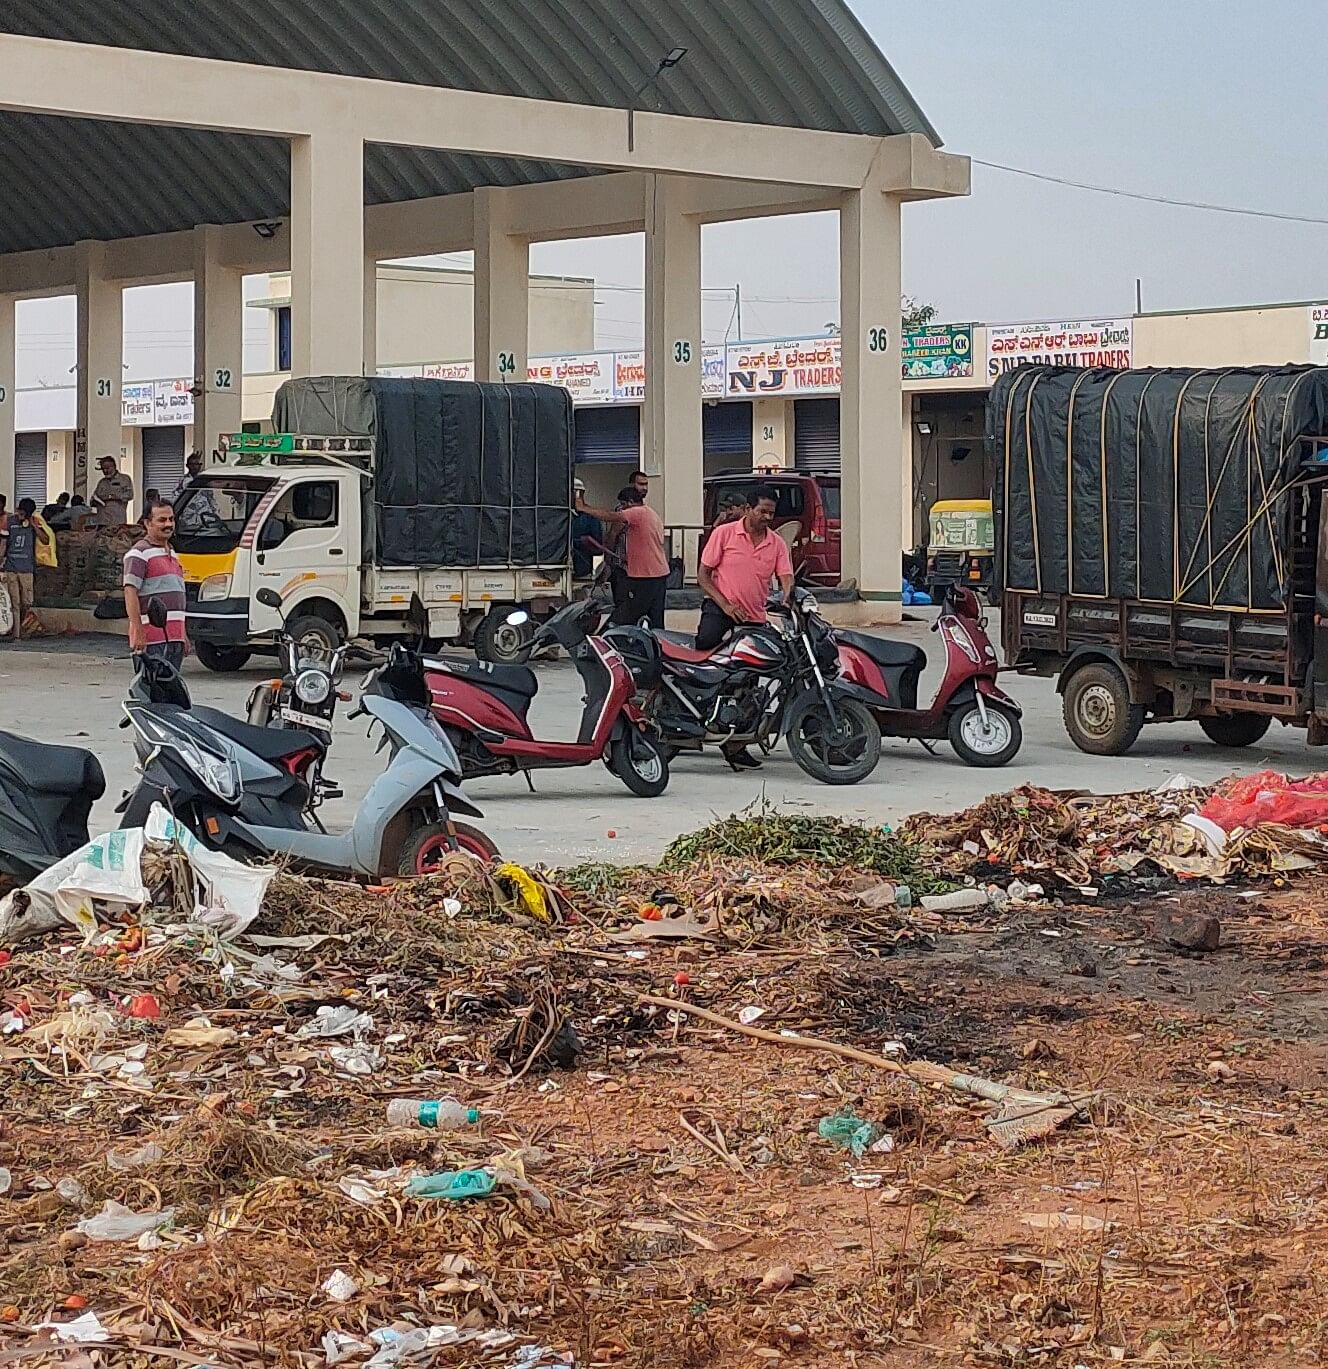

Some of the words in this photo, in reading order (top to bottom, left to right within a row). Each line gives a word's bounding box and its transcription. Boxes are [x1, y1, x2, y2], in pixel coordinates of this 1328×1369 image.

[869, 328, 886, 351] 36
[913, 335, 951, 347] TRADERS
[955, 339, 967, 349] KK
[674, 341, 690, 362] 35
[1080, 349, 1130, 369] TRADERS
[499, 353, 515, 373] 34
[215, 369, 231, 387] 32
[793, 367, 841, 388] TRADERS
[98, 379, 112, 396] 31
[763, 427, 774, 440] 34
